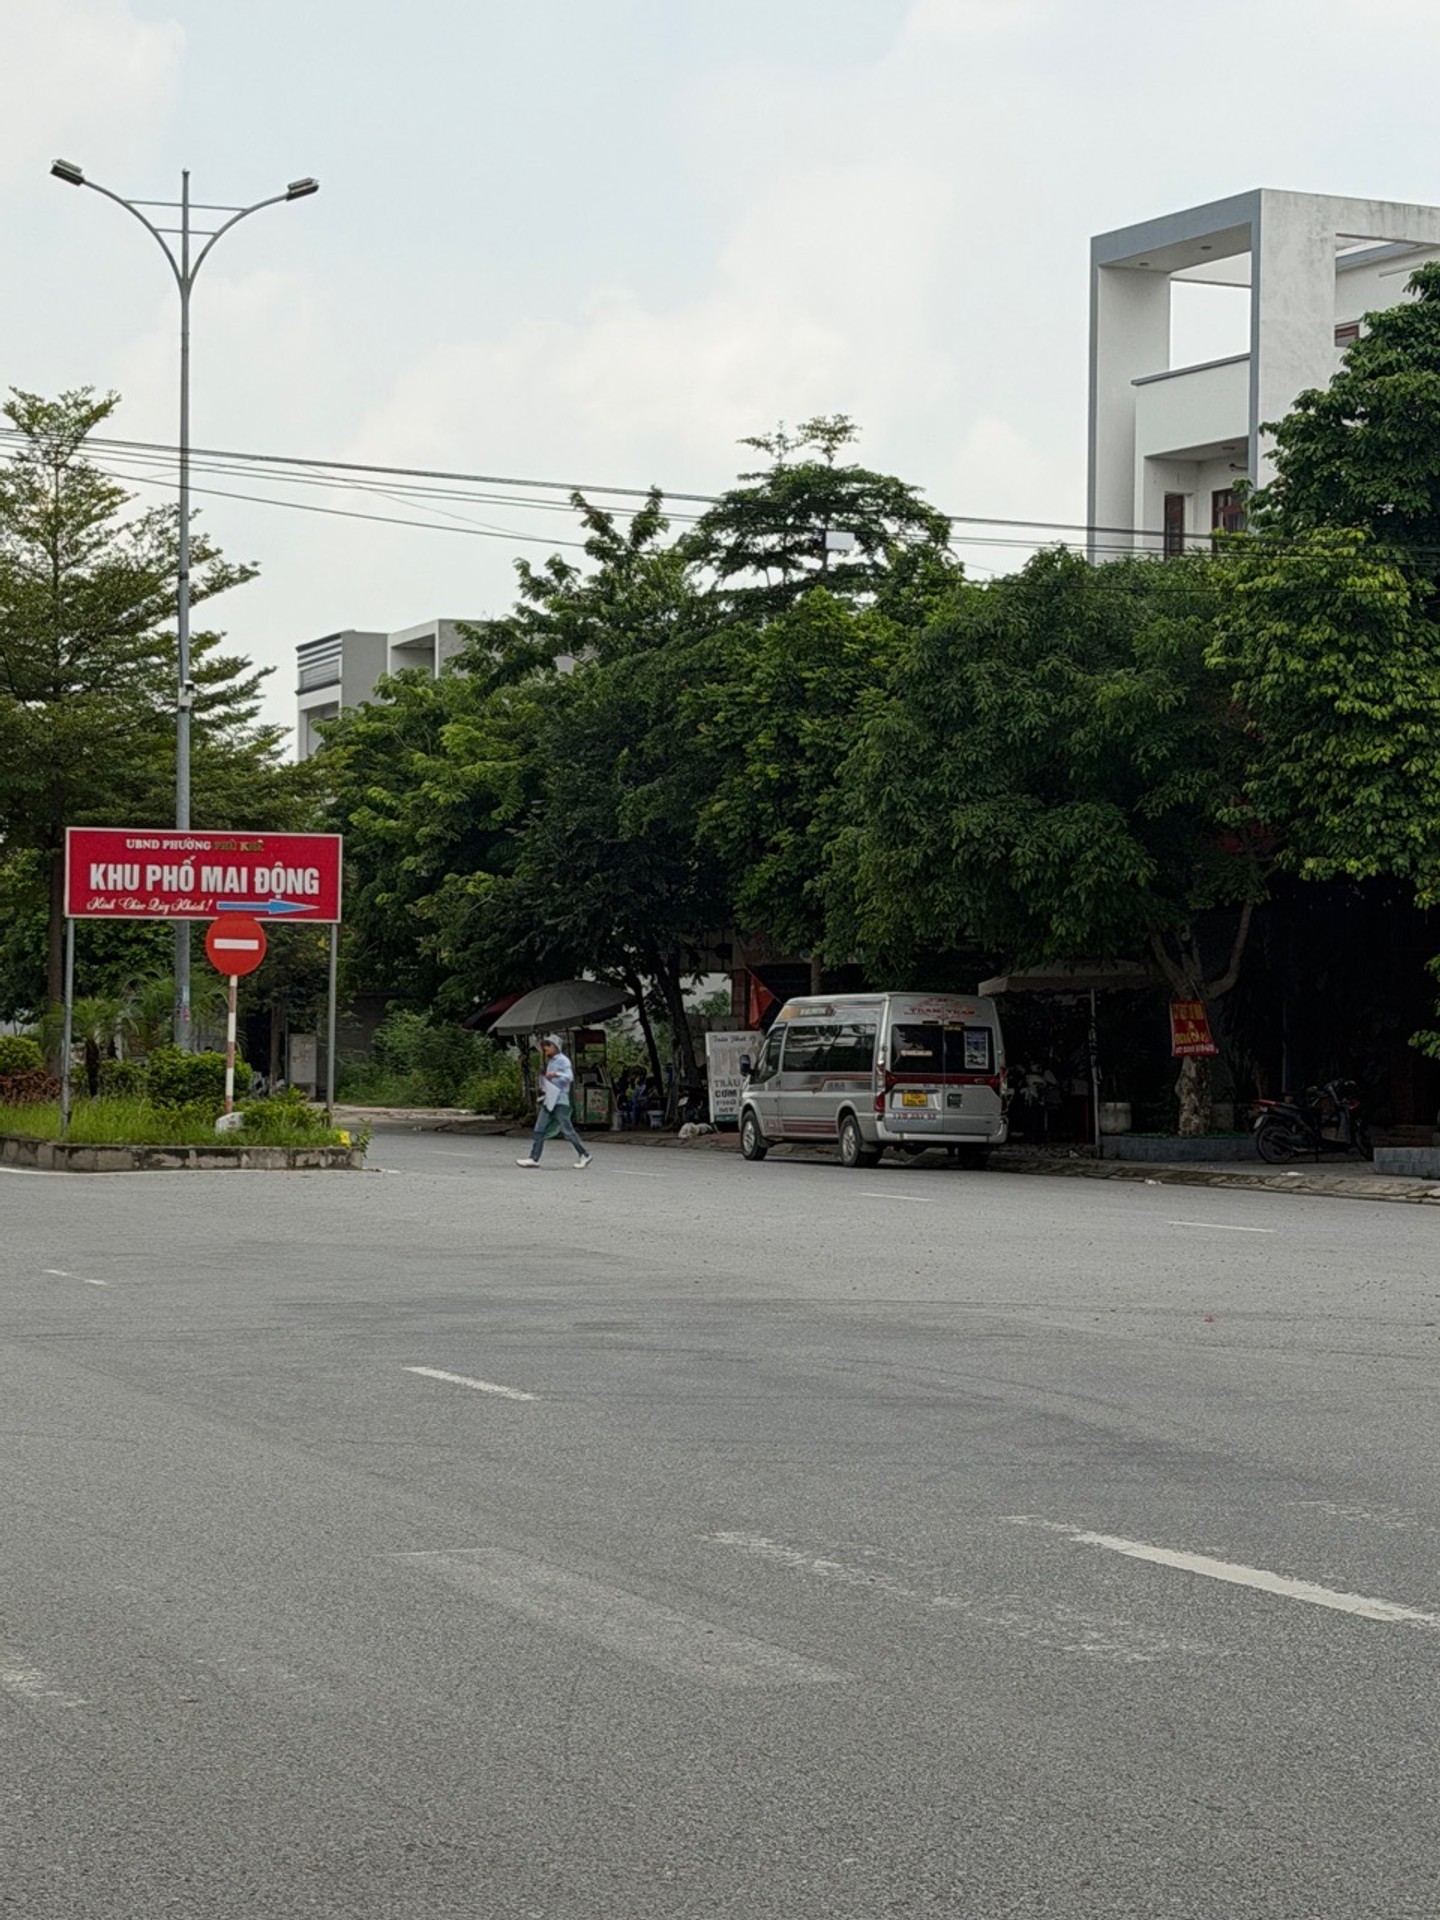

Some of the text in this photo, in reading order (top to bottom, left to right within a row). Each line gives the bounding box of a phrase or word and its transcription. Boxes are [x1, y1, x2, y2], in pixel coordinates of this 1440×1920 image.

[126, 839, 160, 850] UBND
[162, 837, 211, 850] PHƯỜNG
[89, 855, 320, 899] KHU PHỐ MAI ĐỘNG
